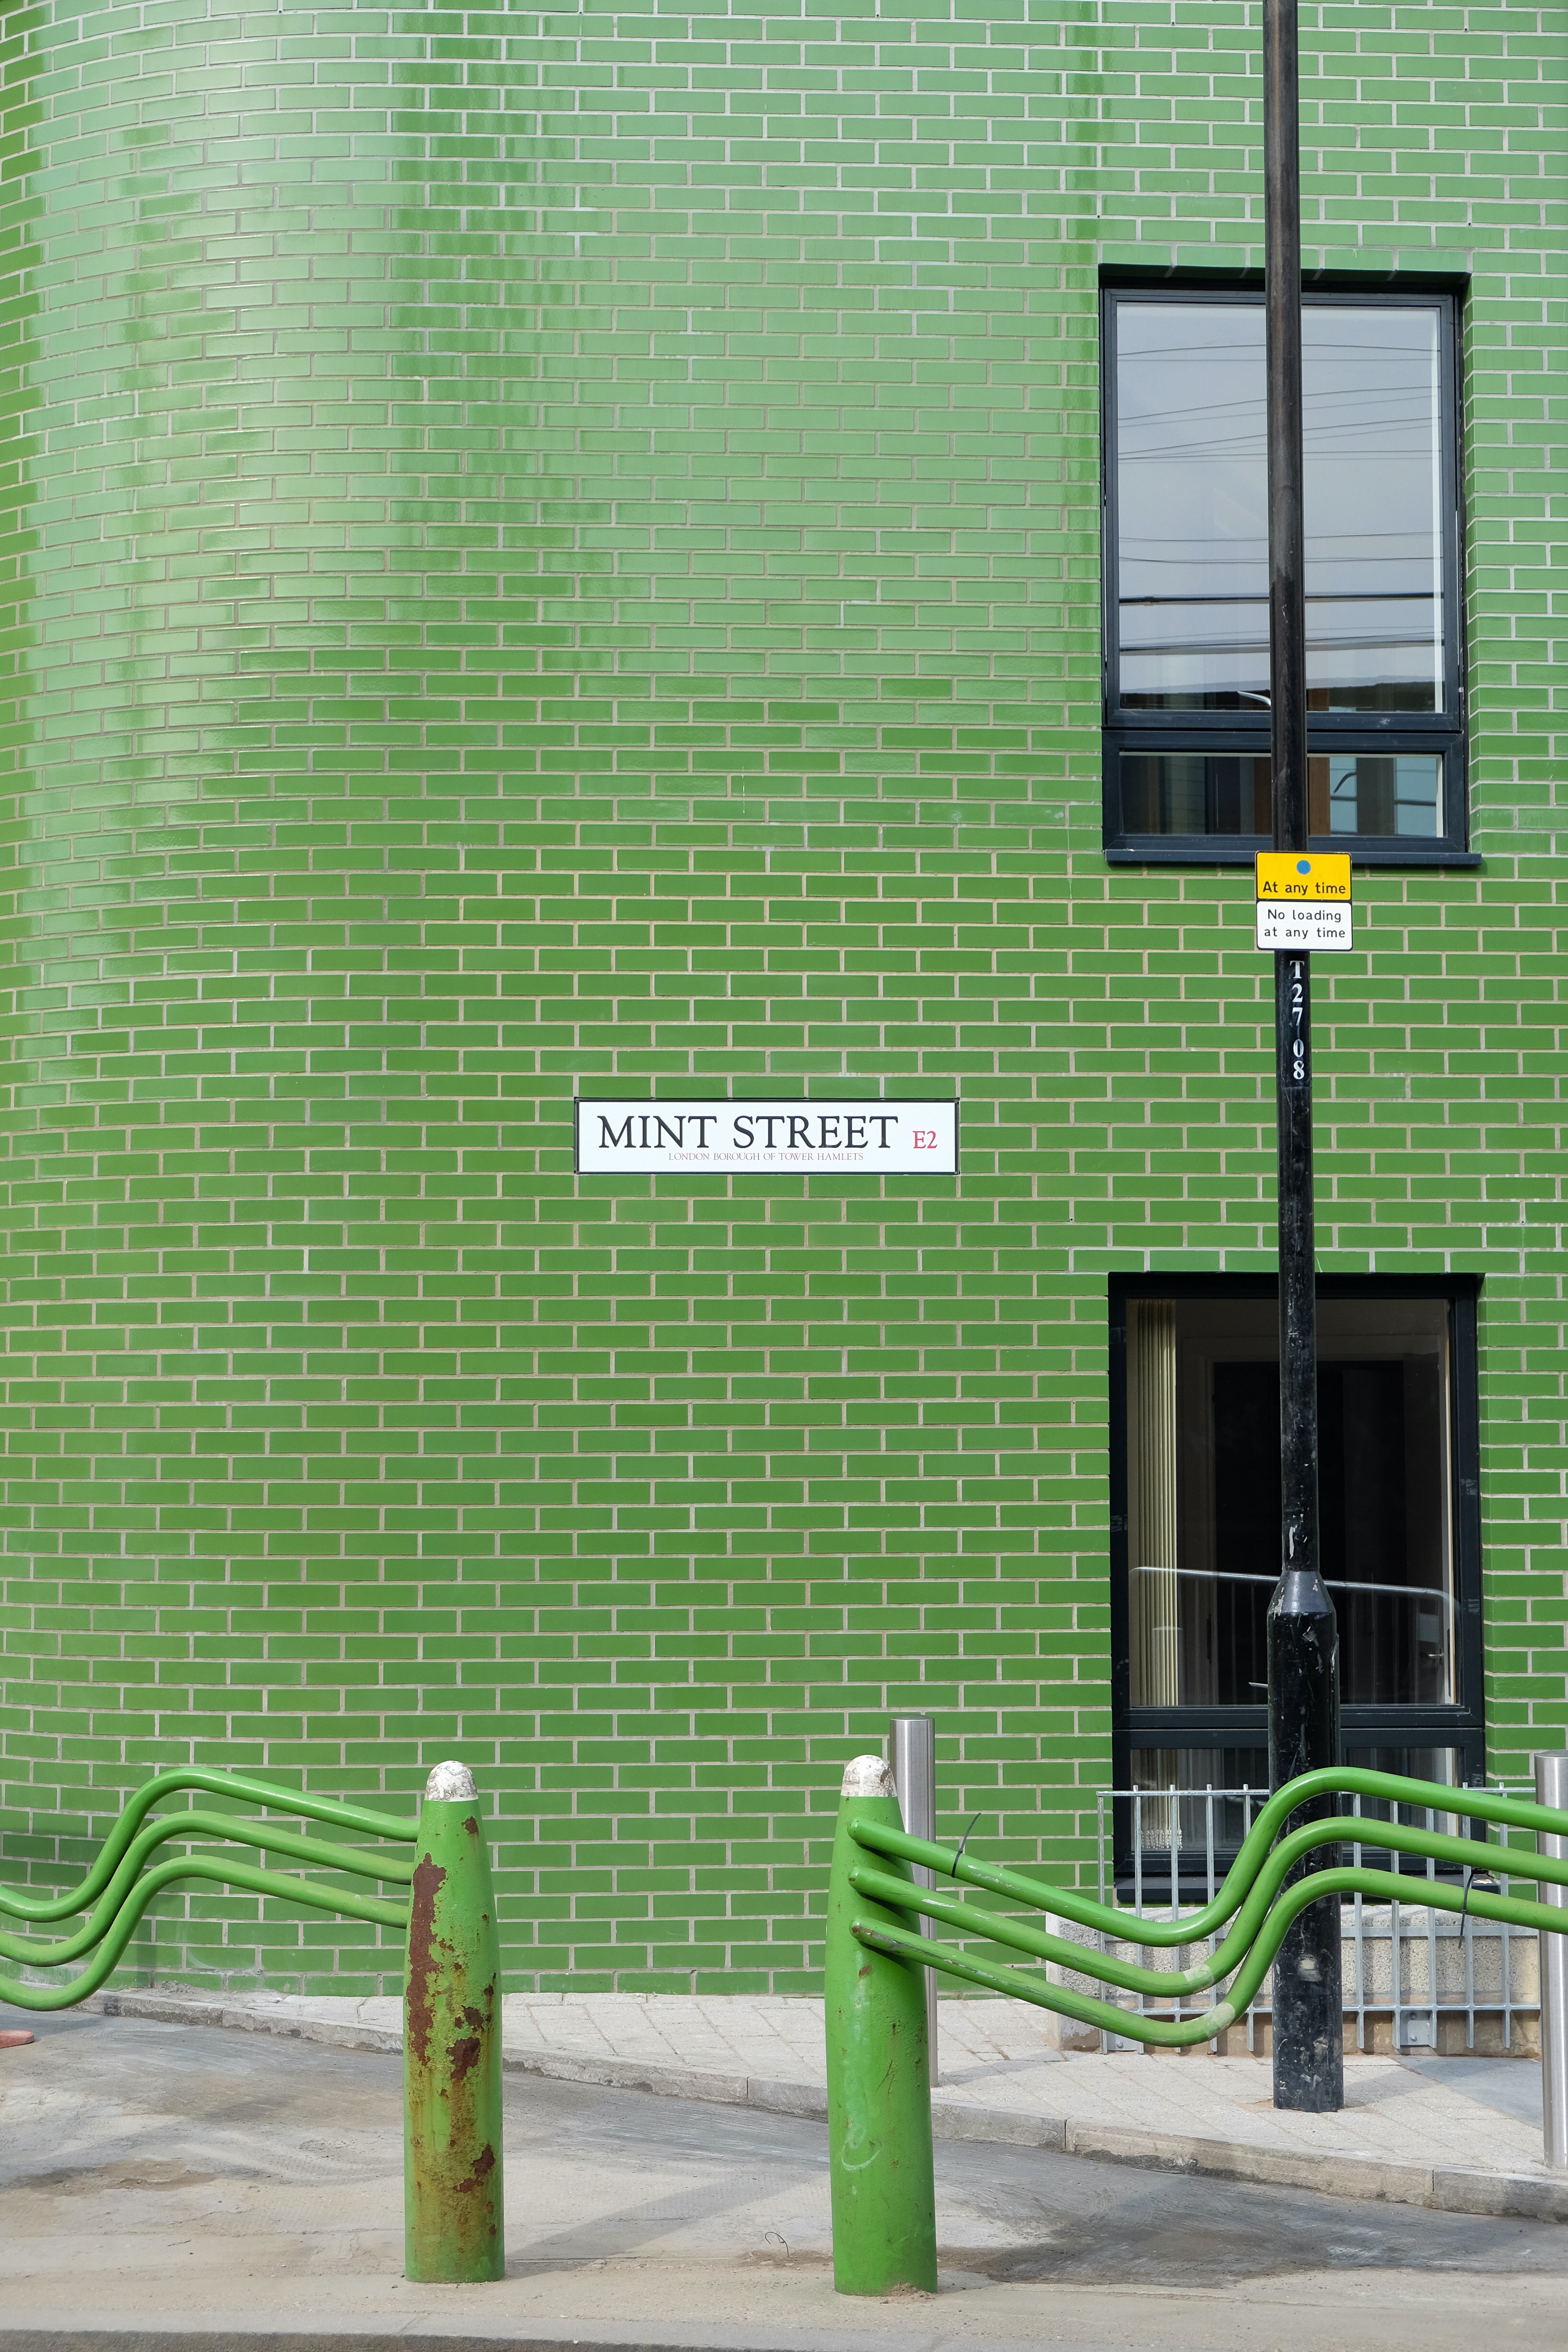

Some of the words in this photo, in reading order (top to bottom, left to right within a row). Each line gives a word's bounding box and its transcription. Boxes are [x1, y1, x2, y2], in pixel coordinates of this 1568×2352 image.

[1262, 881, 1278, 893] At
[1285, 884, 1308, 896] any
[1315, 882, 1346, 894] time
[1268, 908, 1285, 920] No
[1293, 909, 1341, 923] loading
[1264, 927, 1277, 937] at
[1286, 929, 1309, 939] any
[1317, 927, 1345, 938] time
[597, 1115, 717, 1148] MINT
[733, 1115, 898, 1149] STREET
[913, 1130, 938, 1149] E2
[669, 1152, 710, 1161] LONDON
[713, 1152, 760, 1161] BOROUGH
[763, 1152, 775, 1161] OF
[778, 1152, 814, 1161] TOWER
[817, 1152, 864, 1161] HAMLETS
